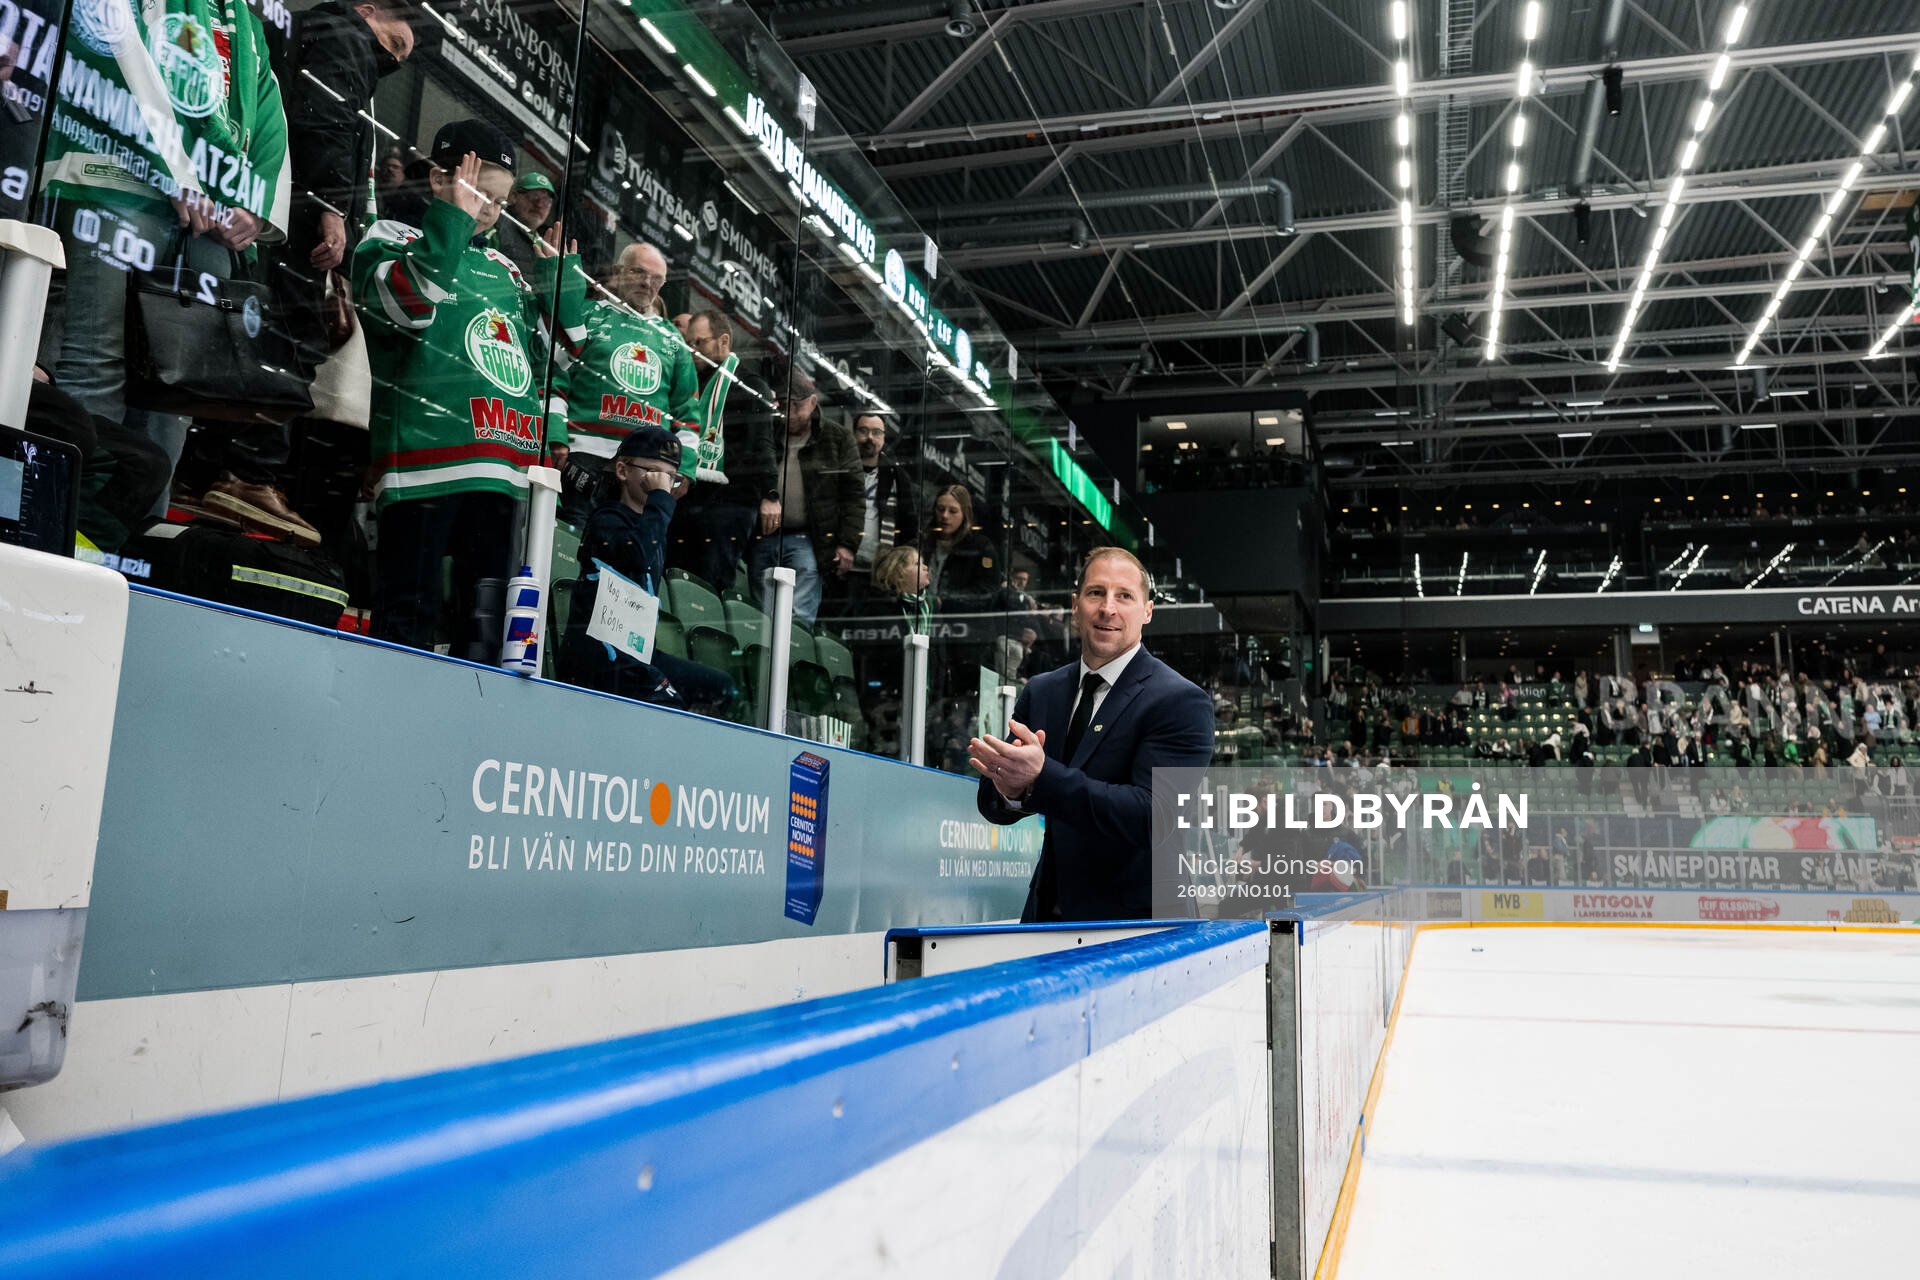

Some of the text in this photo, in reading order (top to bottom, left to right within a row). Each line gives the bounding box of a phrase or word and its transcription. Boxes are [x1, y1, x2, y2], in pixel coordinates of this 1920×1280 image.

[746, 92, 785, 168] NÄSTA
[720, 218, 778, 287] SMIDMEK
[470, 396, 542, 441] MAXI
[601, 394, 662, 425] MAXI
[475, 428, 541, 452] ICA STORMARKNA
[1798, 597, 1886, 616] CATENA
[676, 784, 770, 834] NOVUM
[790, 816, 815, 834] CERNITOL
[791, 830, 813, 846] NOVUM
[939, 819, 1033, 852] CERNITOL NOVUM
[468, 834, 510, 870] BLI
[523, 831, 575, 871] VÄN
[584, 840, 632, 872] MED
[640, 843, 676, 873] DIN
[684, 846, 765, 875] PROSTATA
[939, 856, 1032, 878] BLI VÄN MED DIN PROSTATA
[1614, 850, 1781, 880] SKÅNEPORTAR
[1493, 894, 1521, 910] MVB
[1573, 895, 1654, 909] FLYTGOLV
